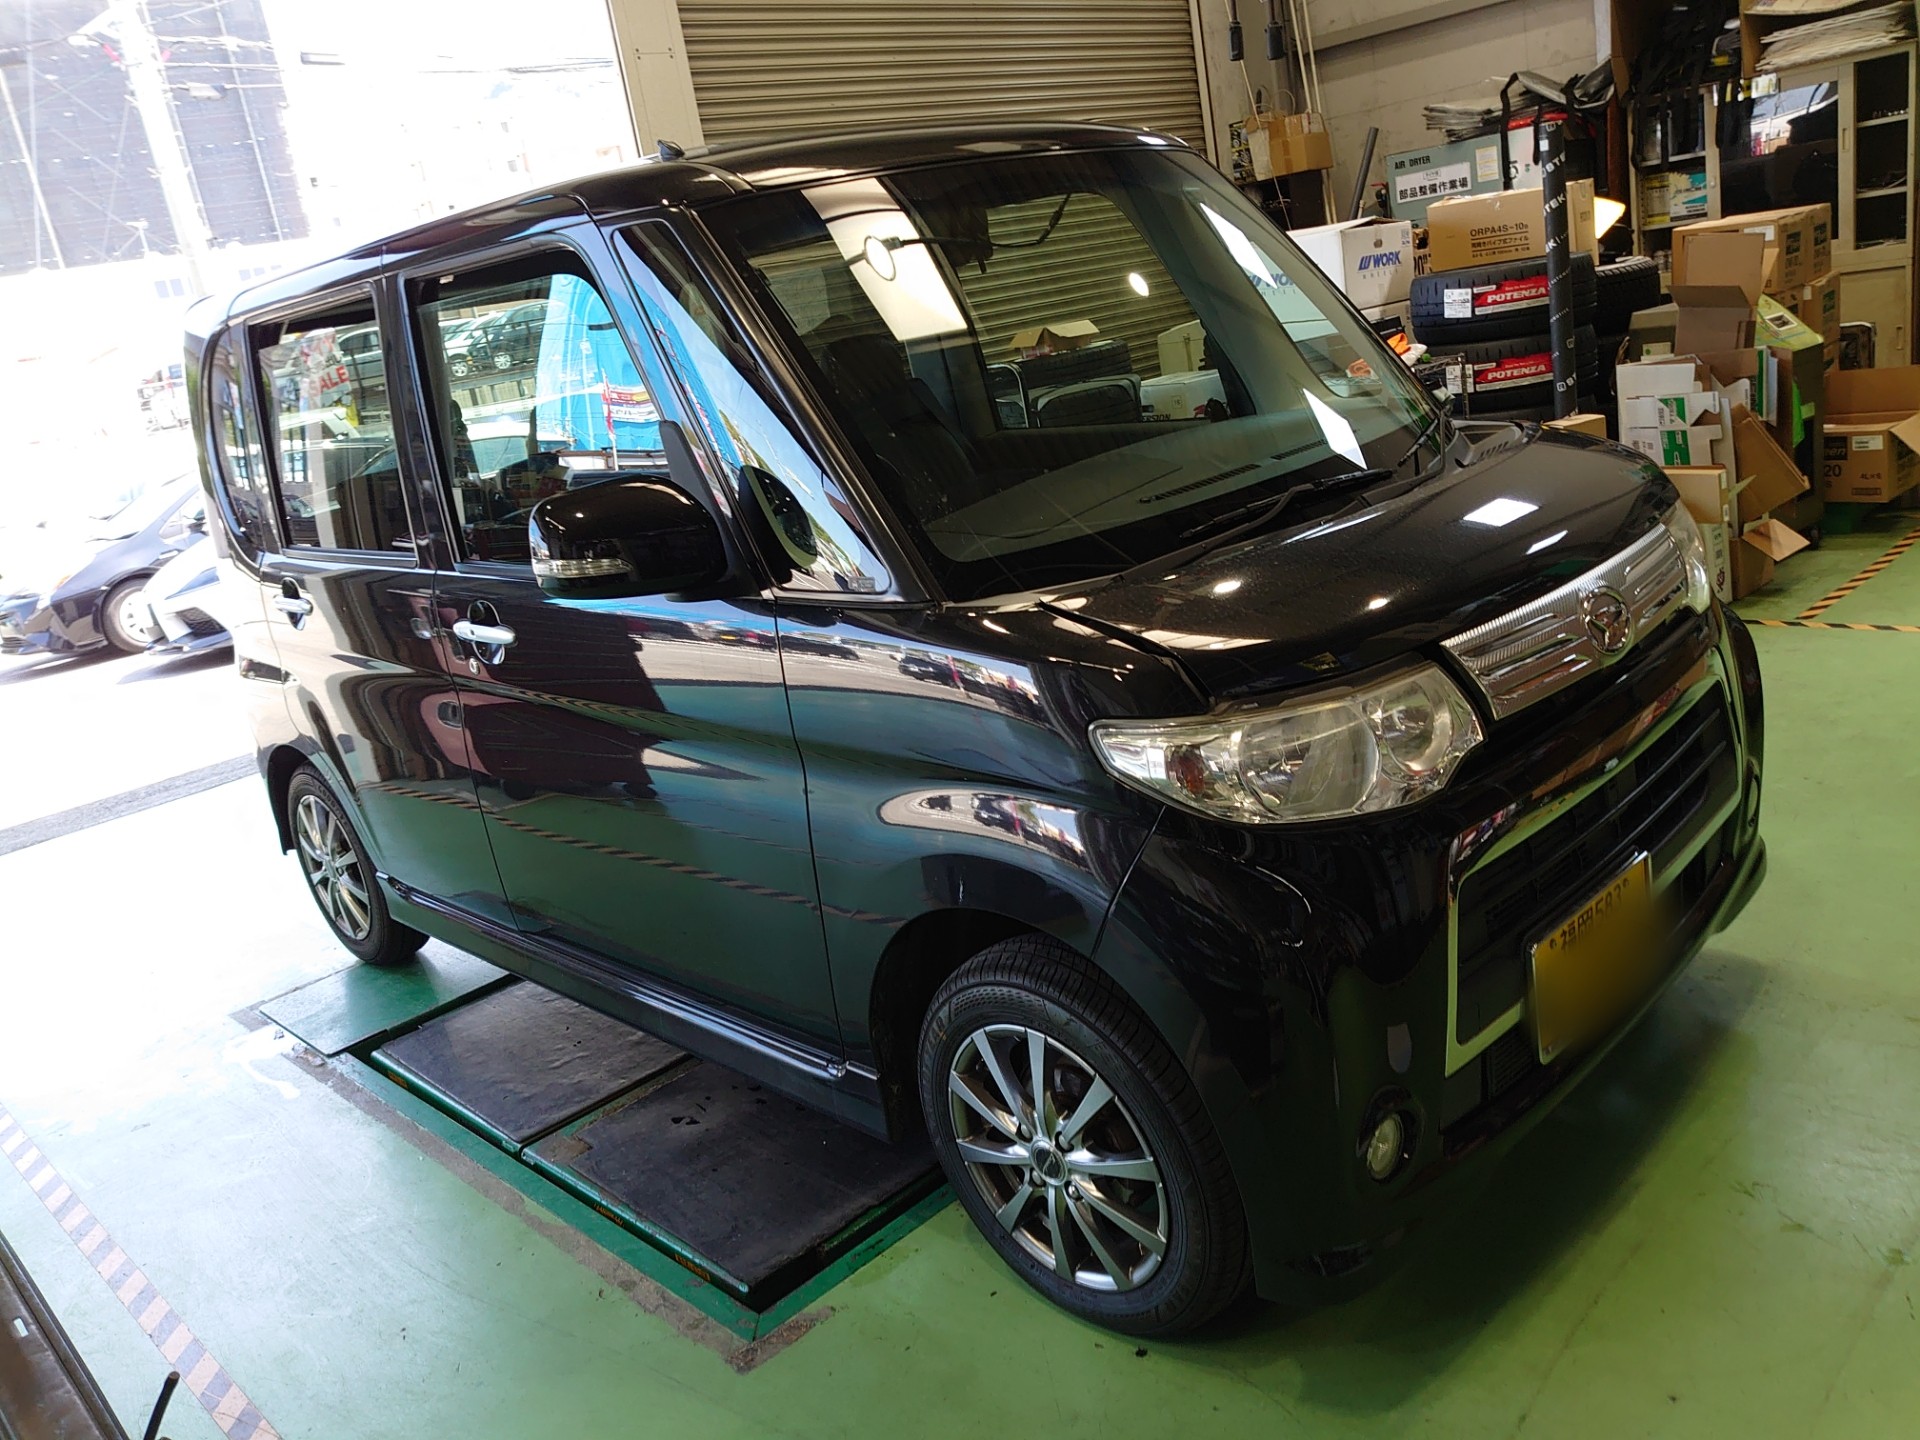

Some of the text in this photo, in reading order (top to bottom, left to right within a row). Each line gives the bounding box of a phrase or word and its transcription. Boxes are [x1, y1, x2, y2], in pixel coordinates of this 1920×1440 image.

[1394, 155, 1431, 170] AIR DRYER
[1398, 176, 1469, 201] 部品整備作業場
[1371, 250, 1402, 269] WORK
[1486, 286, 1547, 304] POTENZA
[1487, 363, 1547, 381] POTENZA
